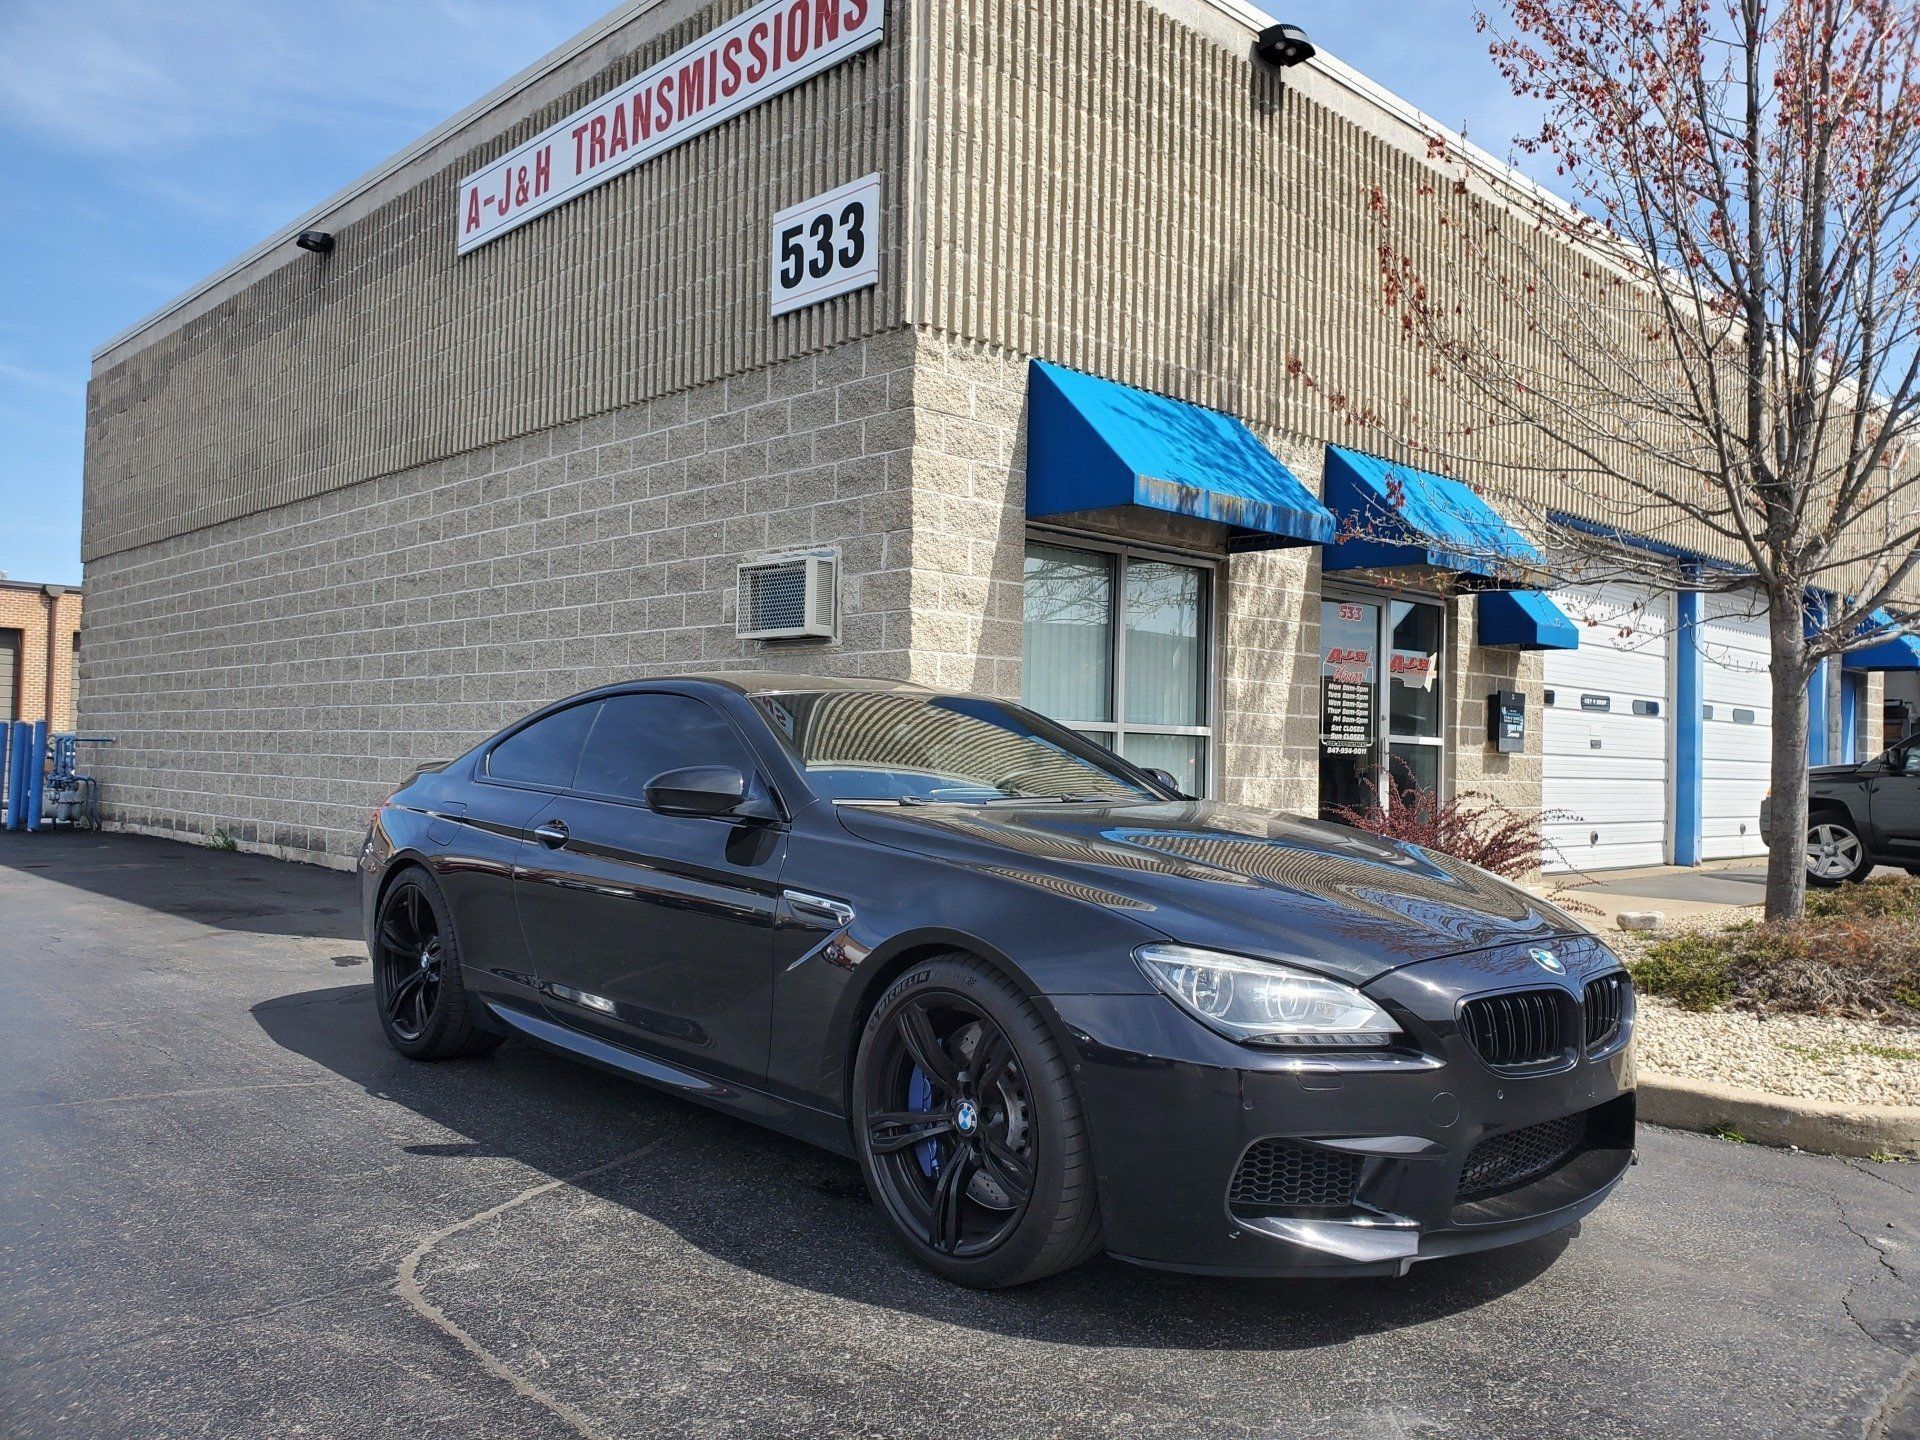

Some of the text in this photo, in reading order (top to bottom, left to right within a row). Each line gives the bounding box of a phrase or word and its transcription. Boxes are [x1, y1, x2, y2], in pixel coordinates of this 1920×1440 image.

[465, 0, 868, 235] A-J&H TRANSMISSIONS
[779, 200, 866, 290] 533
[1339, 603, 1363, 621] 533
[1328, 683, 1369, 693] Mon 8am-5pm
[1327, 691, 1369, 700] Tues 8am-5pm
[1342, 700, 1369, 708] 8am-5pm
[1342, 708, 1369, 716] 8am-5pm
[1342, 716, 1369, 724] 8am-5pm
[1331, 724, 1365, 733] Sat CLOSED
[1330, 732, 1365, 741] Sun CLOSED
